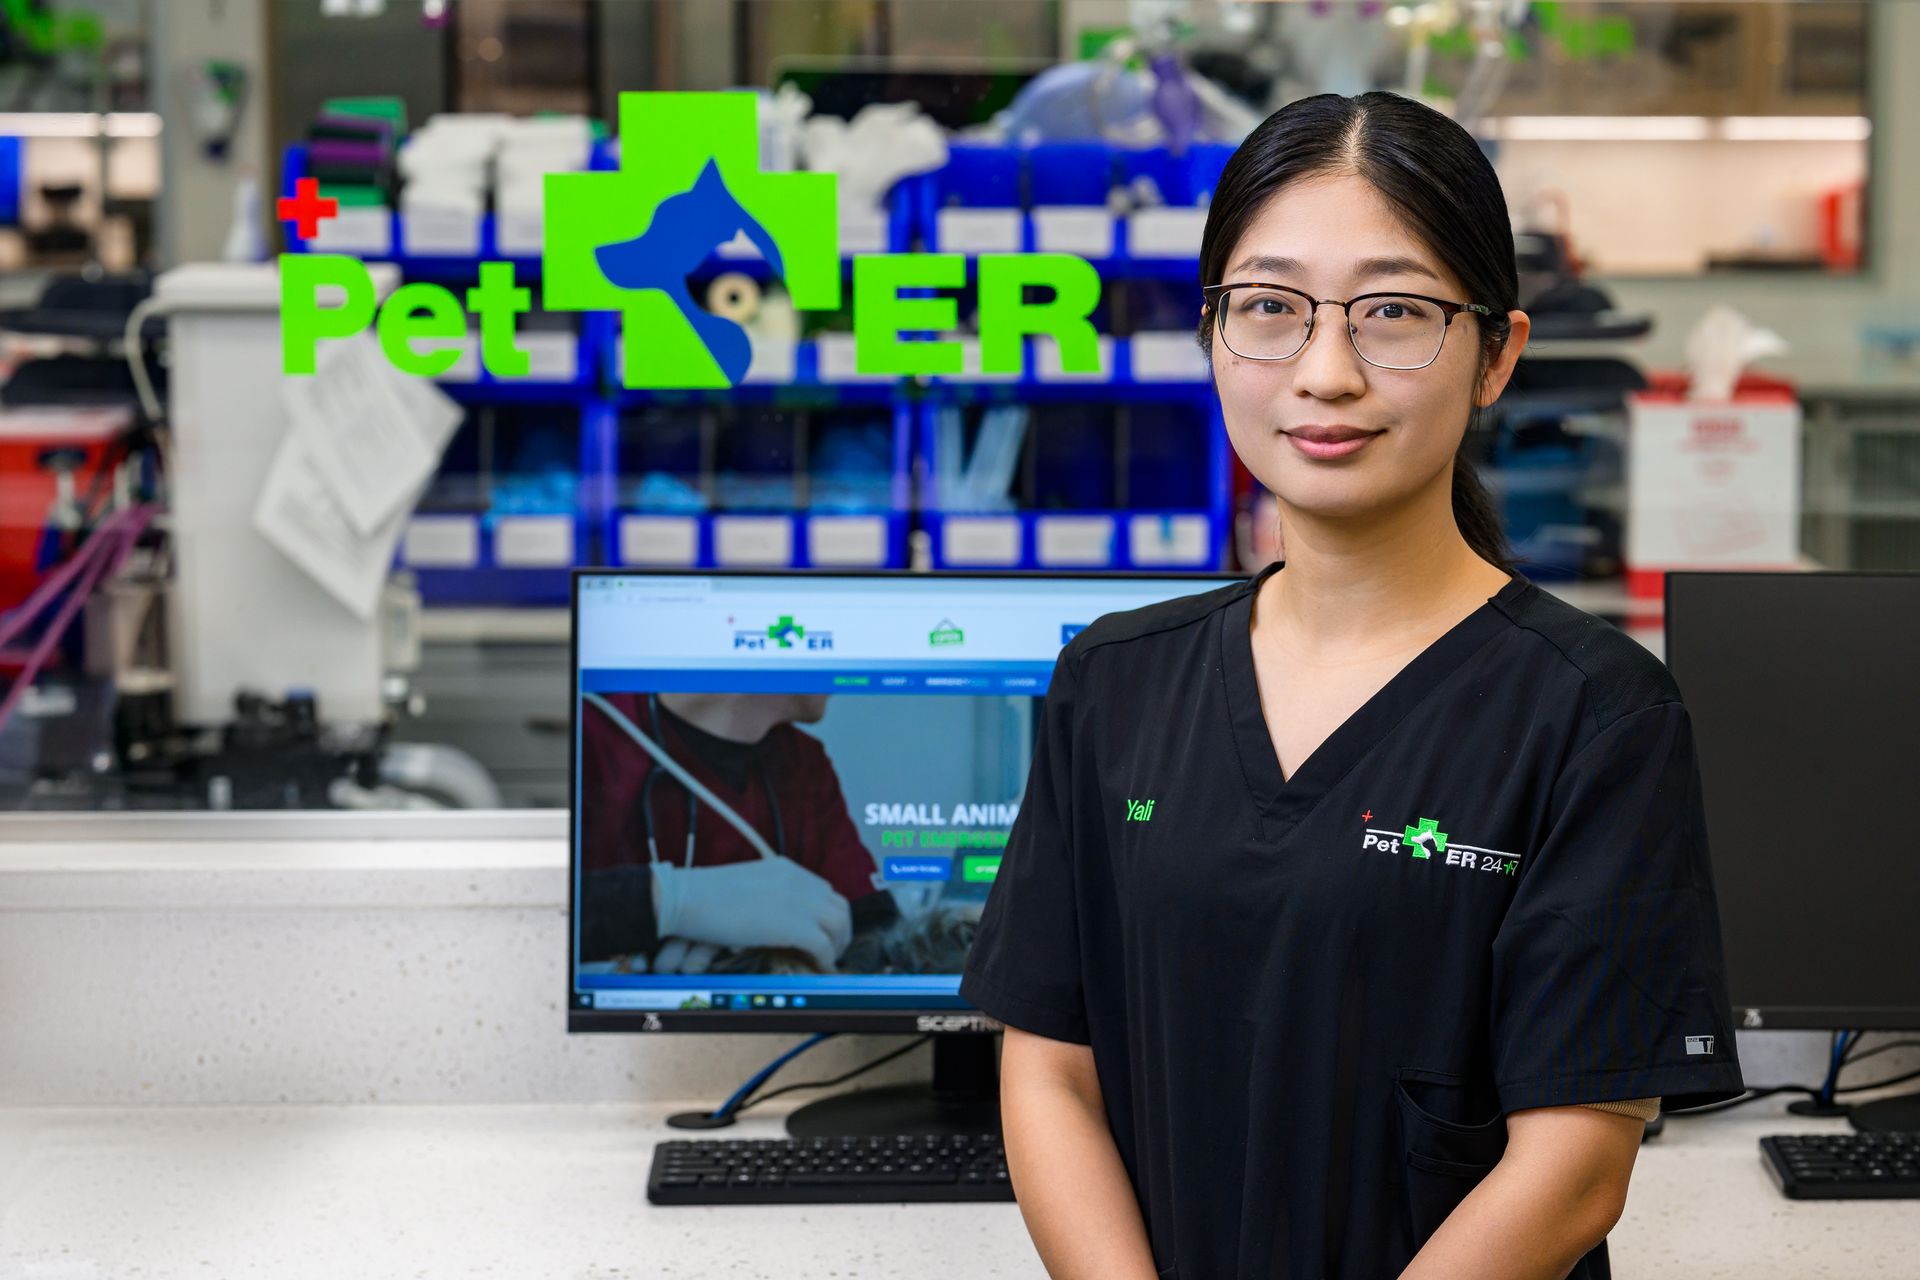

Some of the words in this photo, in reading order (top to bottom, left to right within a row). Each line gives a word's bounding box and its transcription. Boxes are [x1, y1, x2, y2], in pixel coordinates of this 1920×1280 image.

[280, 254, 531, 376] Pet
[854, 254, 1101, 374] ER
[734, 637, 766, 650] Pet
[807, 638, 833, 650] ER
[864, 803, 946, 825] SMALL
[1127, 799, 1155, 821] Yali
[882, 831, 915, 847] PET
[1363, 834, 1400, 854] Pet
[1445, 849, 1477, 869] ER
